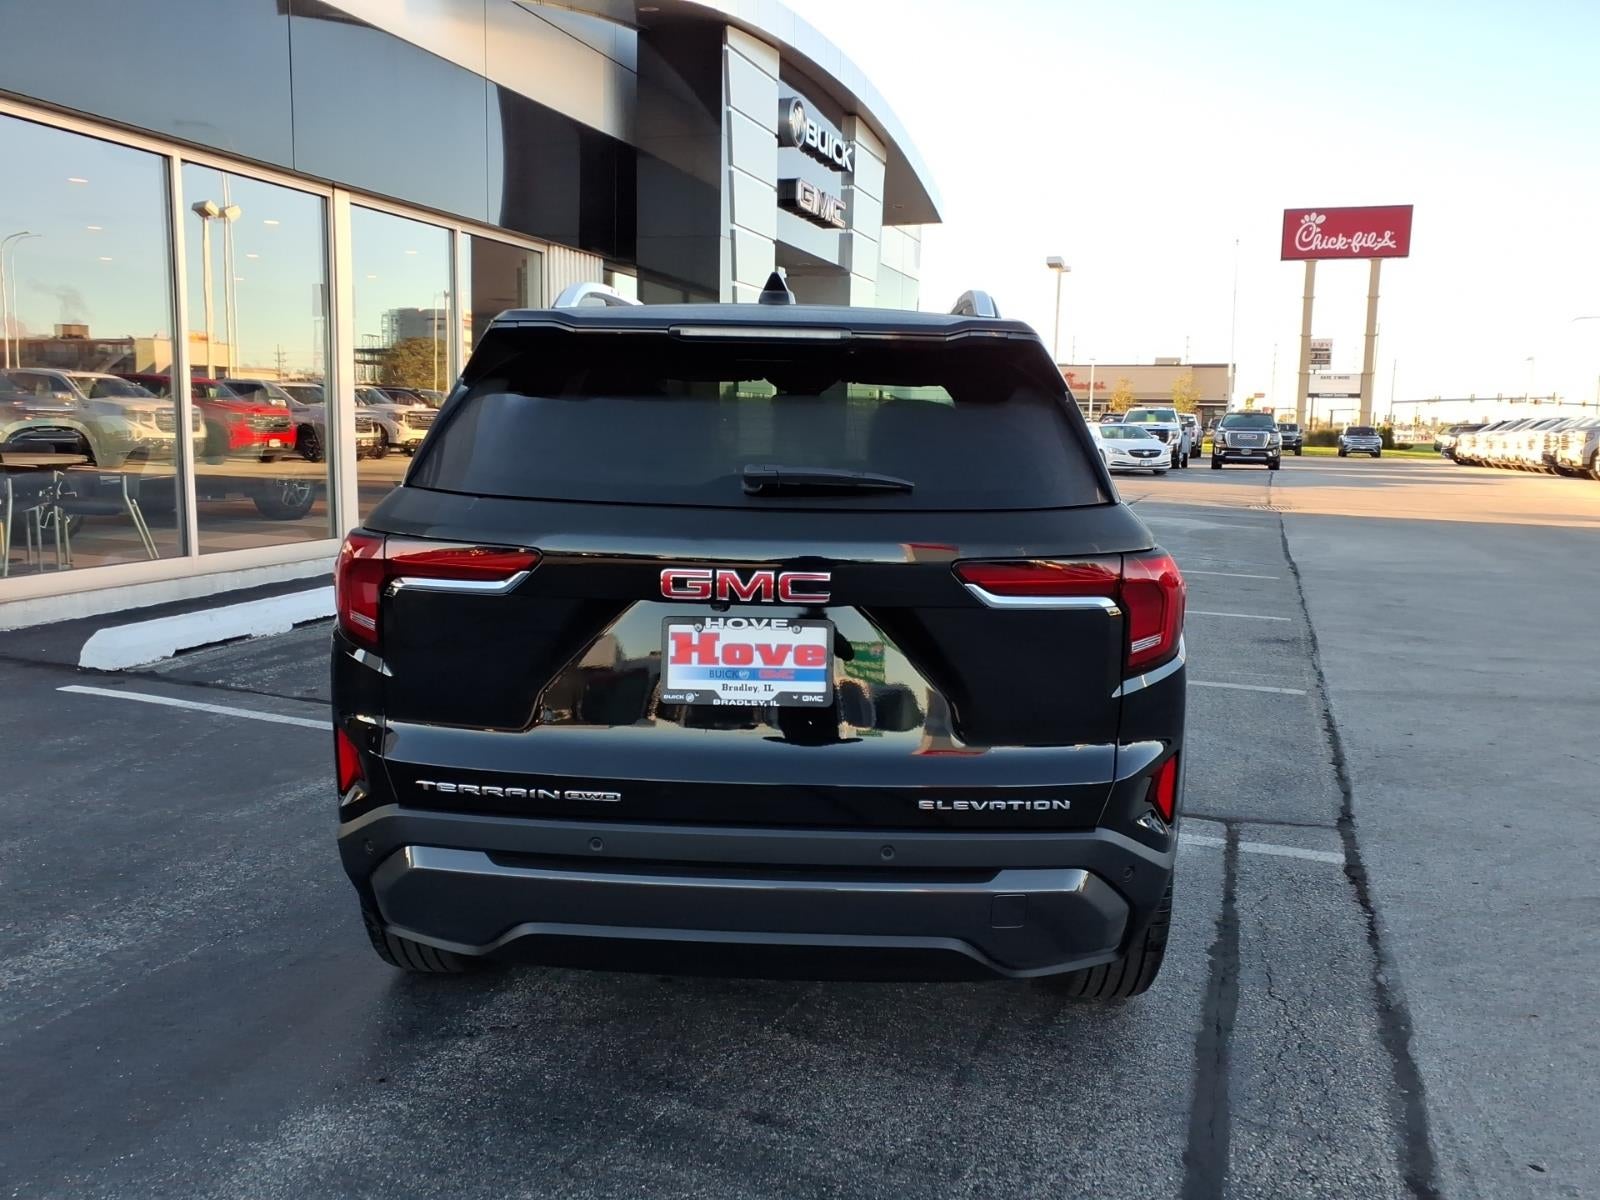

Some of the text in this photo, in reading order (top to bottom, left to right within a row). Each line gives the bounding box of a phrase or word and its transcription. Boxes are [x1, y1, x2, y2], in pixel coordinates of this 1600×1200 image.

[806, 119, 853, 172] BUICK
[799, 179, 846, 228] GMC
[660, 568, 831, 603] GMC
[705, 617, 789, 631] HOVE
[670, 631, 827, 667] Hove
[709, 669, 740, 679] BUICK
[722, 684, 774, 693] Bradley, IL
[712, 699, 767, 707] BRADLEY,
[415, 780, 621, 802] TERRAIN AWD
[918, 800, 1071, 811] ELEVATION
